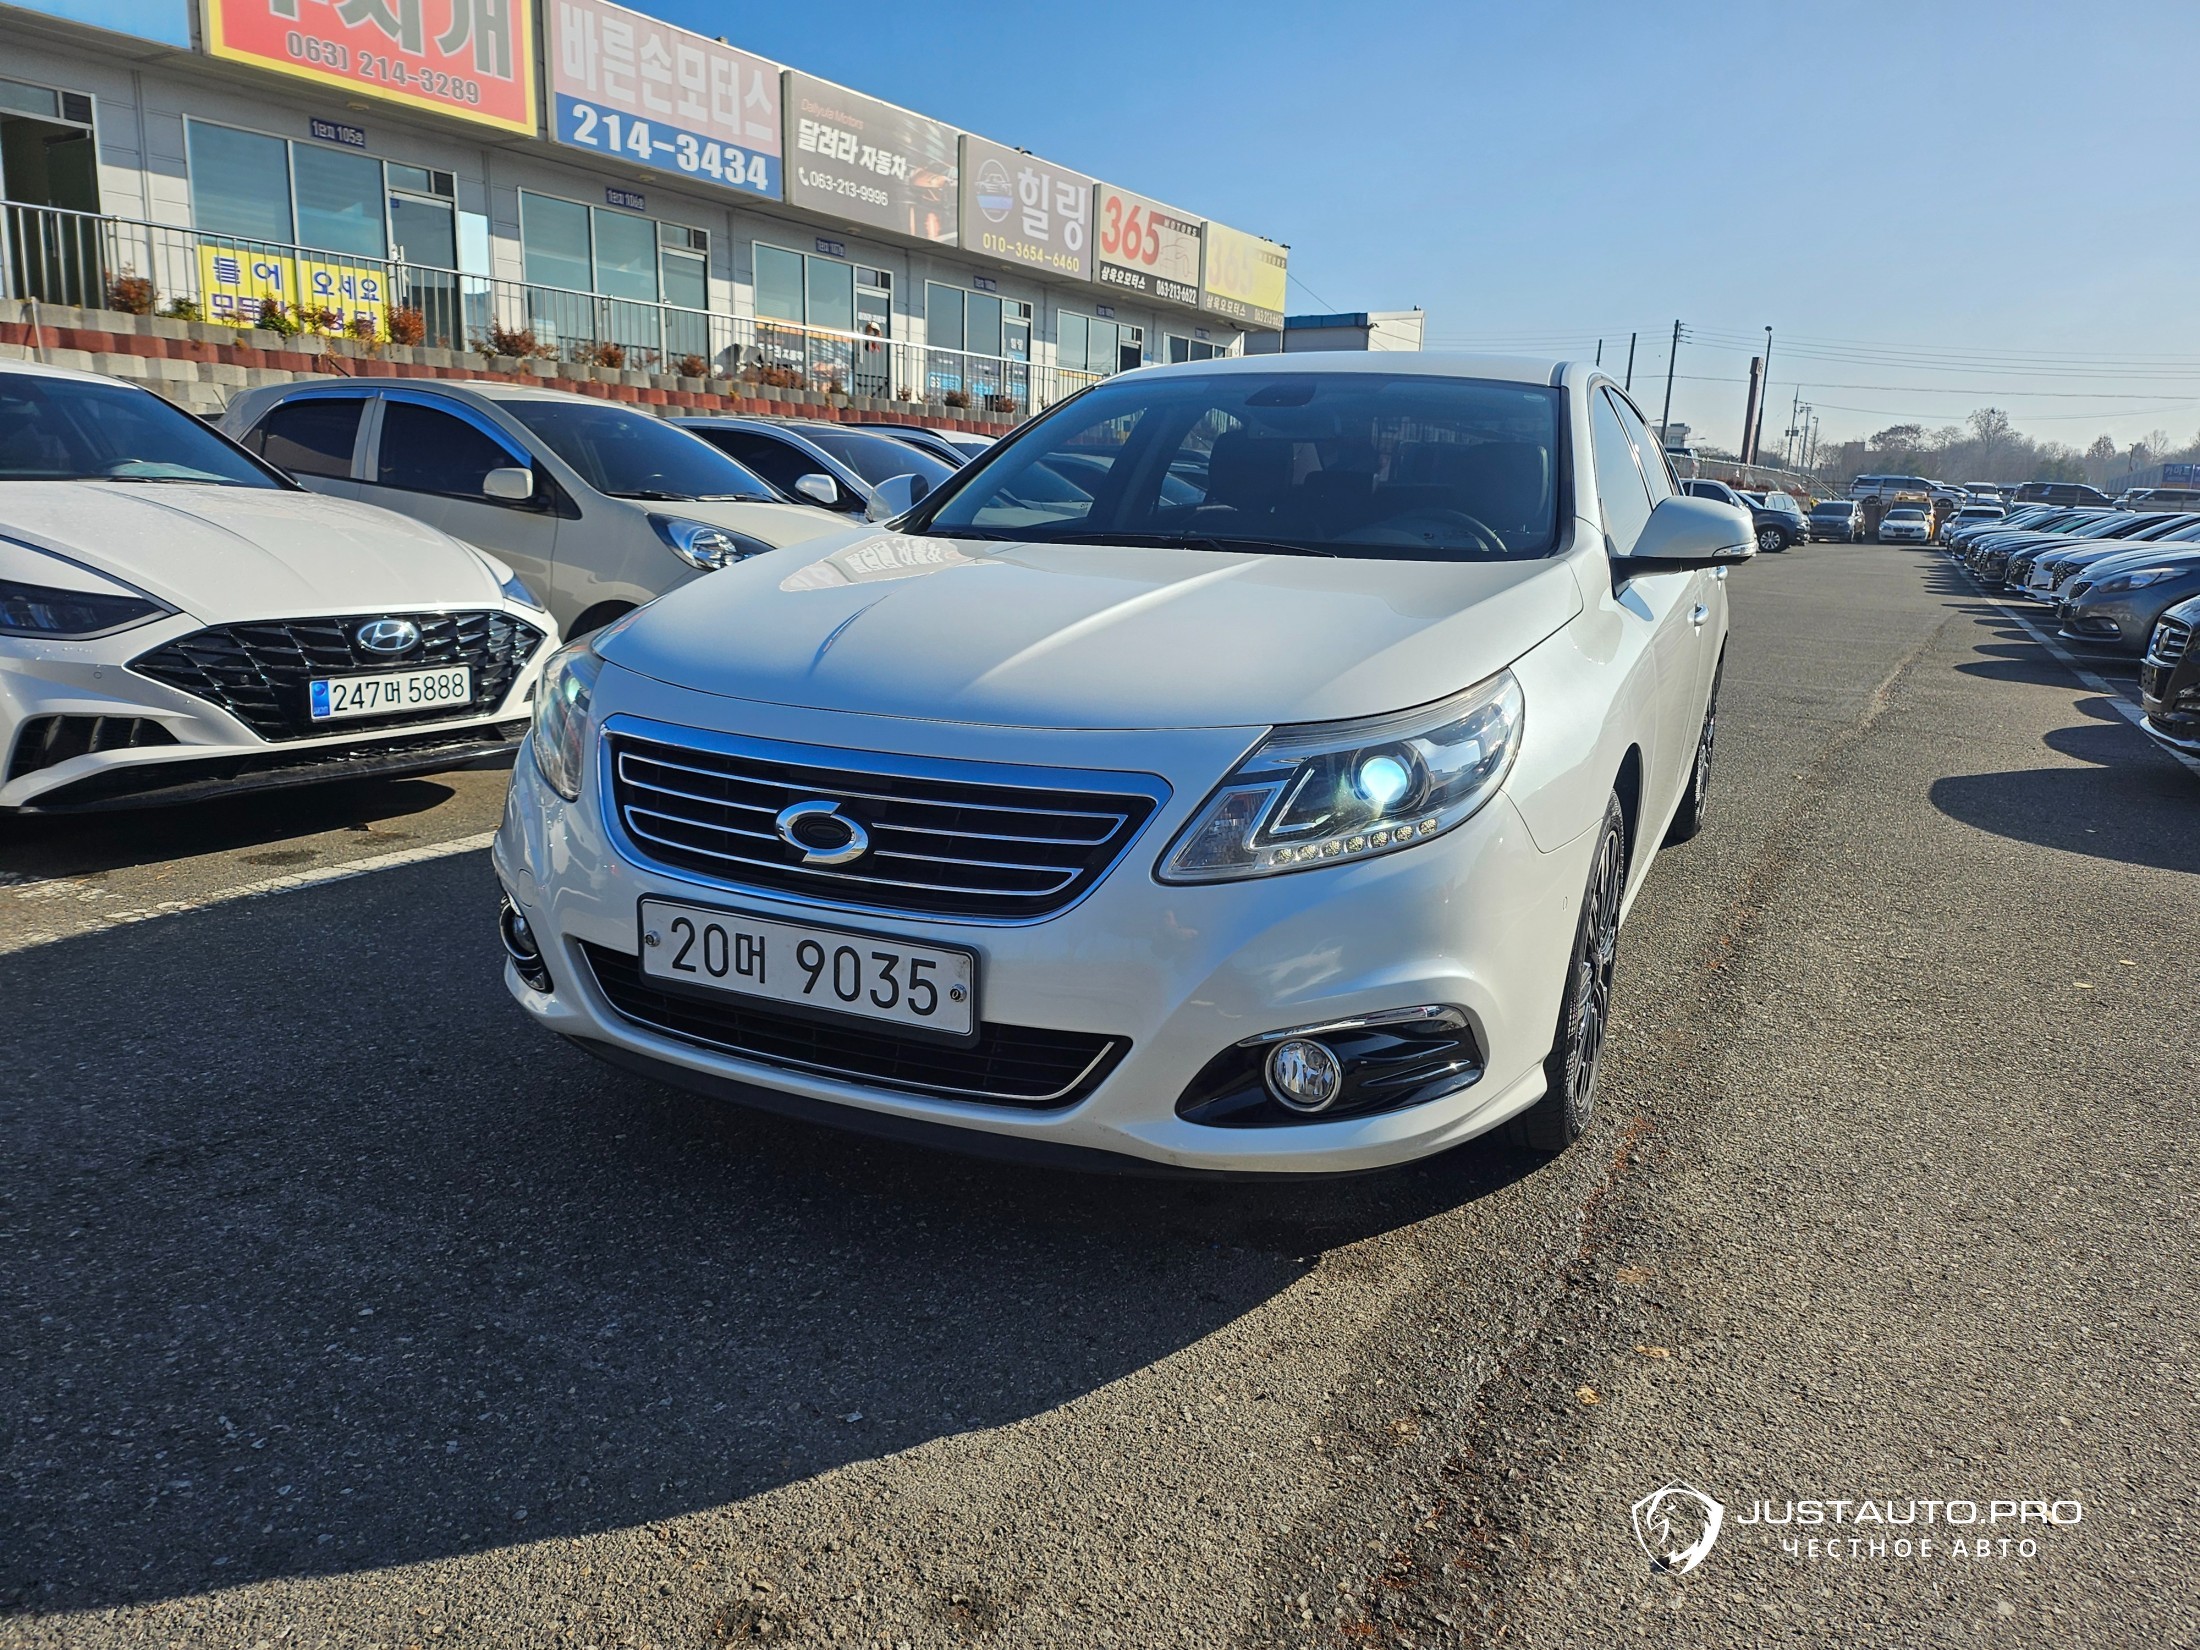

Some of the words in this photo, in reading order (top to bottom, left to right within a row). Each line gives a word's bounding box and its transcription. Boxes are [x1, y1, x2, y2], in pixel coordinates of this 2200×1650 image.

[287, 31, 348, 70] 063)
[359, 51, 480, 104] 214-3289
[559, 2, 774, 142] 바른손모터스
[572, 104, 769, 191] 214-3434
[798, 118, 858, 164] 달려라
[859, 145, 908, 180] 자동차
[810, 171, 889, 206] 063-213-9996
[1017, 167, 1087, 251] 힐링
[982, 233, 1080, 272] 010-3654-6460
[1102, 196, 1163, 266] 365
[1164, 218, 1198, 237] MOTORS
[313, 271, 379, 302] 오세요
[1101, 266, 1146, 290] 삼육오모터스
[1156, 280, 1198, 304] 063-213-6622
[333, 681, 400, 711] 247머
[409, 673, 464, 703] 5888
[671, 917, 766, 984] 20머
[796, 939, 938, 1016] 9035
